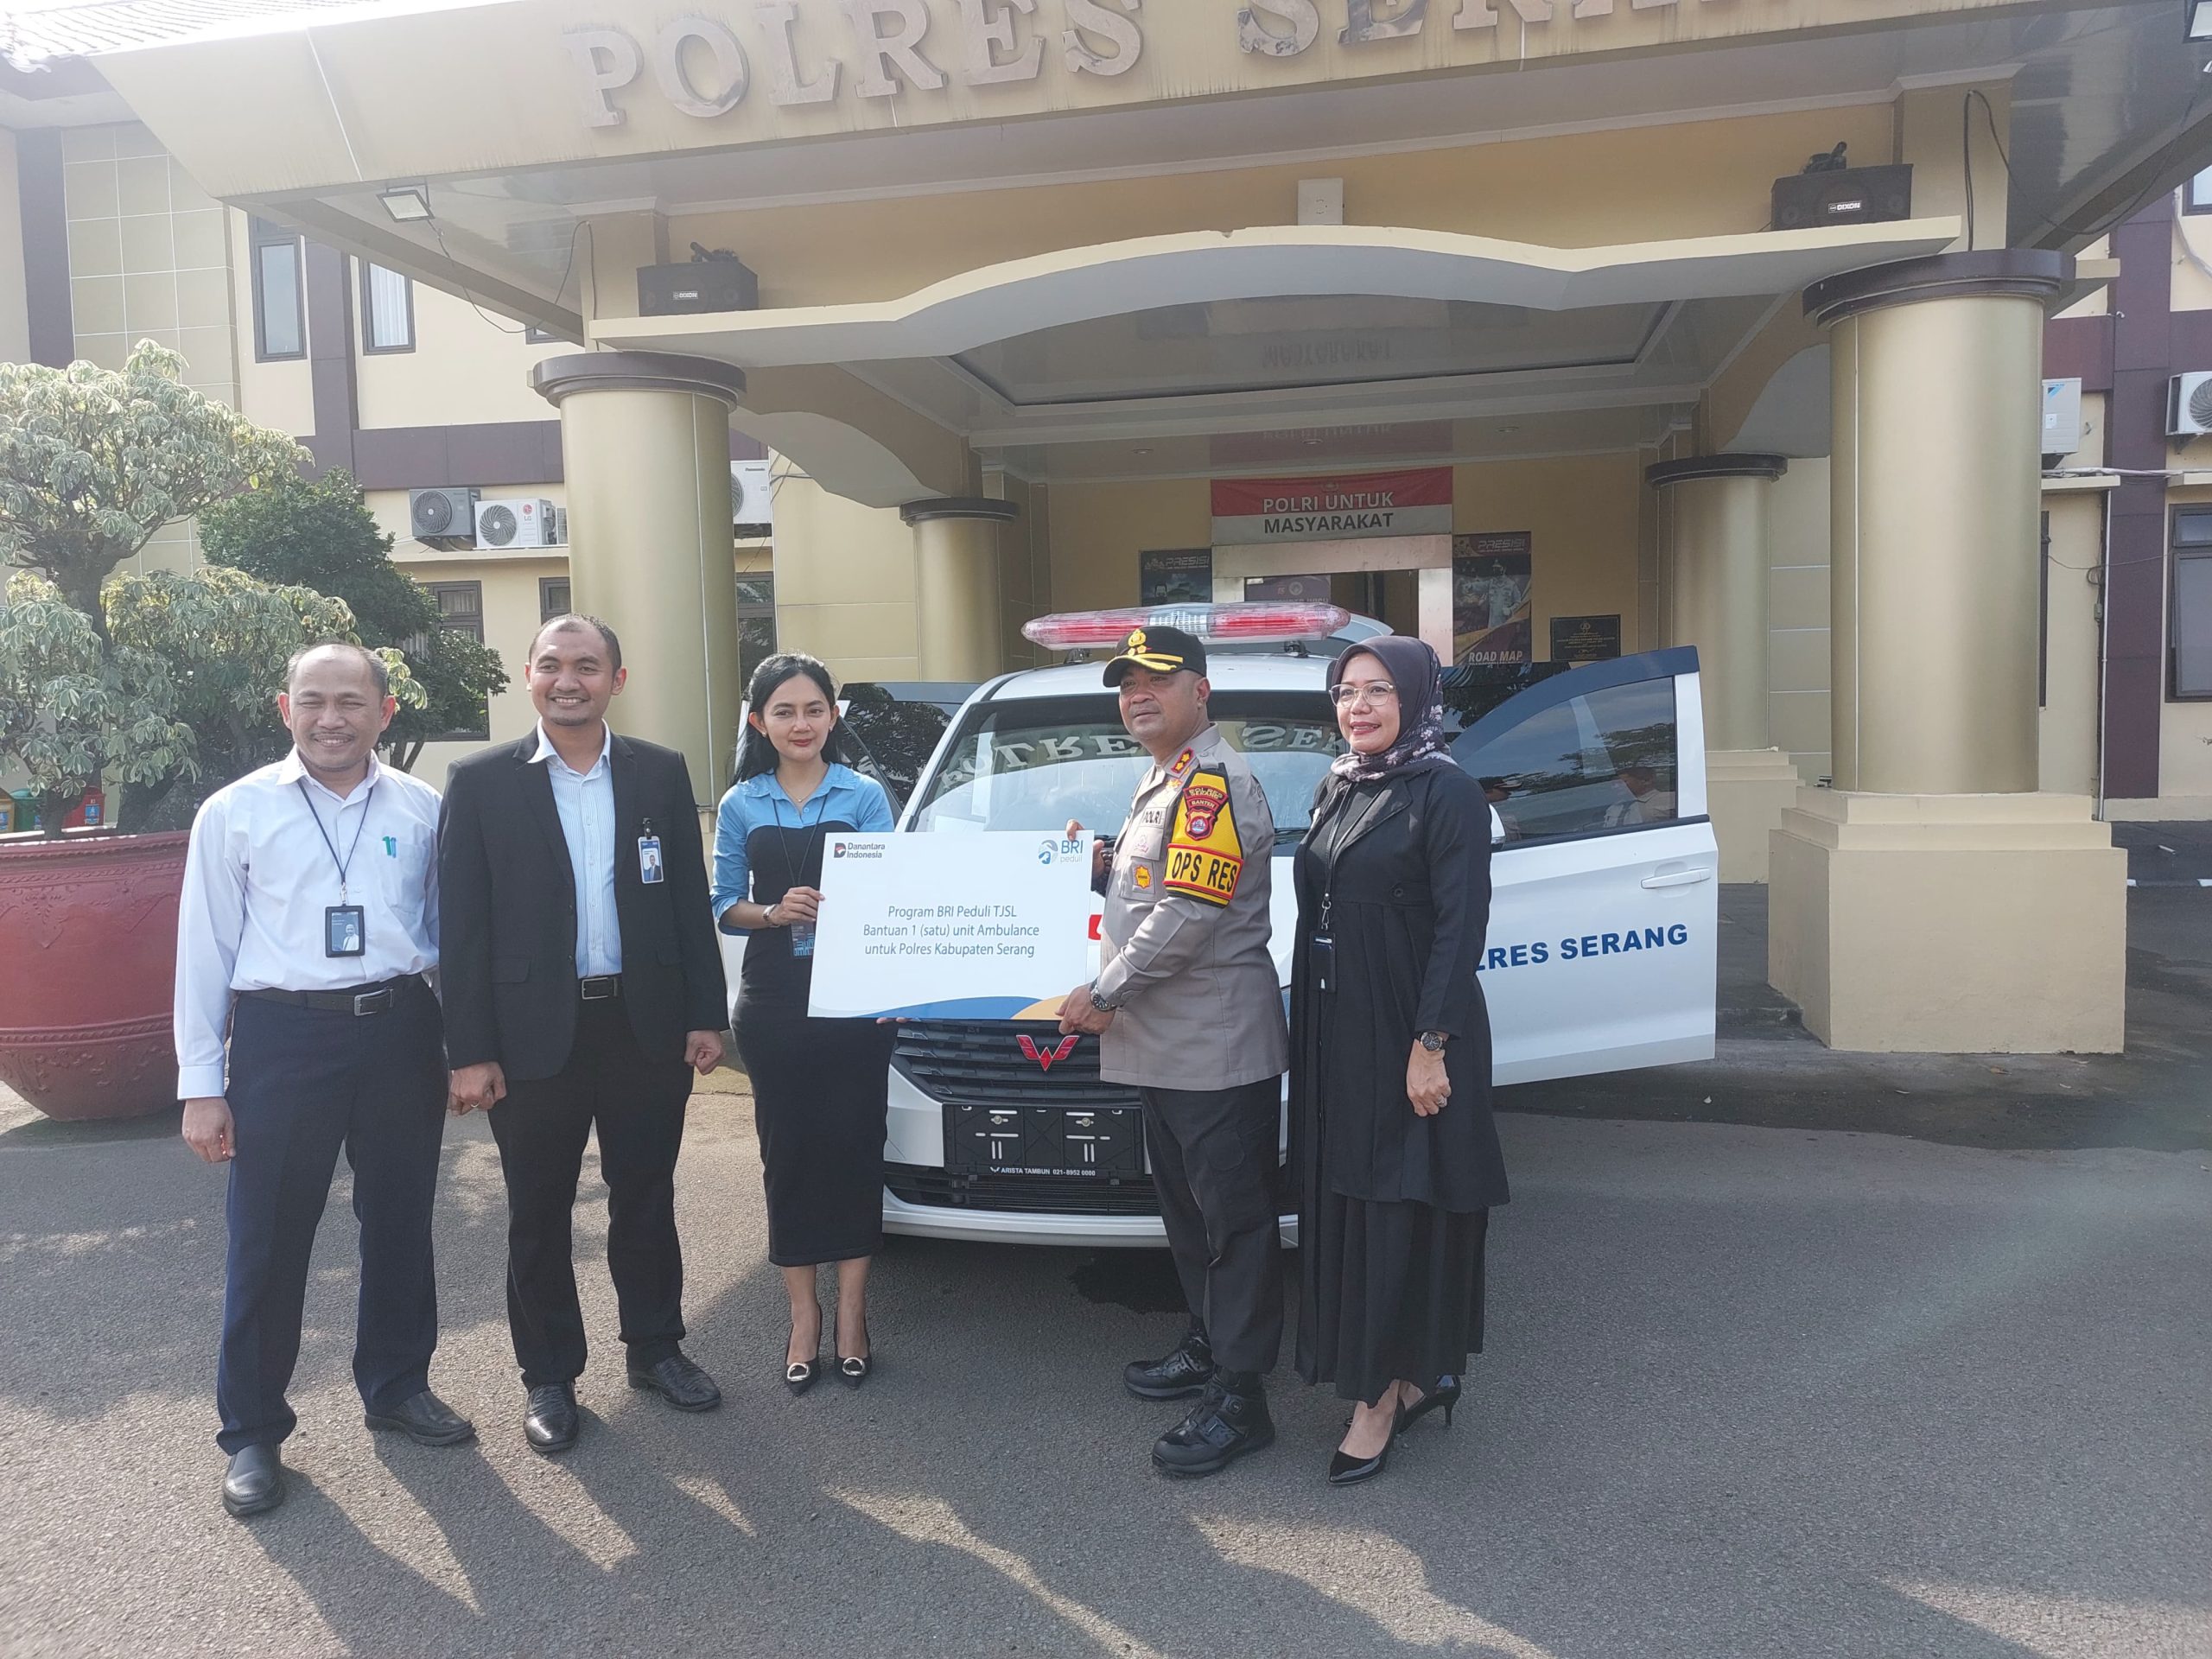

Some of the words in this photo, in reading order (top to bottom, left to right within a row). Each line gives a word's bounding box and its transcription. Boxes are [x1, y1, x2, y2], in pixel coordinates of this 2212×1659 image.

[563, 0, 1142, 129] POLRES
[1262, 495, 1319, 513] POLRI
[1325, 491, 1394, 510] UNTUK
[1264, 512, 1394, 534] MASYARAKAT
[1468, 652, 1497, 662] ROAD
[1500, 651, 1523, 661] MAP
[1191, 799, 1215, 809] BANTEN
[847, 842, 886, 850] Danantara
[1061, 839, 1084, 854] BRI
[847, 850, 882, 859] Indonesia
[1060, 855, 1083, 864] peduli
[1172, 851, 1203, 882] OPS
[1207, 858, 1238, 893] RES
[888, 906, 934, 921] Program
[938, 906, 954, 918] BRI
[957, 906, 991, 918] Peduli
[994, 906, 1017, 918] TJSL
[863, 925, 907, 936] Bantuan
[912, 925, 916, 936] 1
[920, 924, 950, 938] (satu)
[953, 924, 975, 936] unit
[977, 924, 1039, 937] Ambulance
[1560, 924, 1688, 960] SERANG
[865, 943, 896, 955] untuk
[899, 943, 931, 955] Polres
[935, 943, 994, 958] Kabupaten
[996, 943, 1034, 958] Serang
